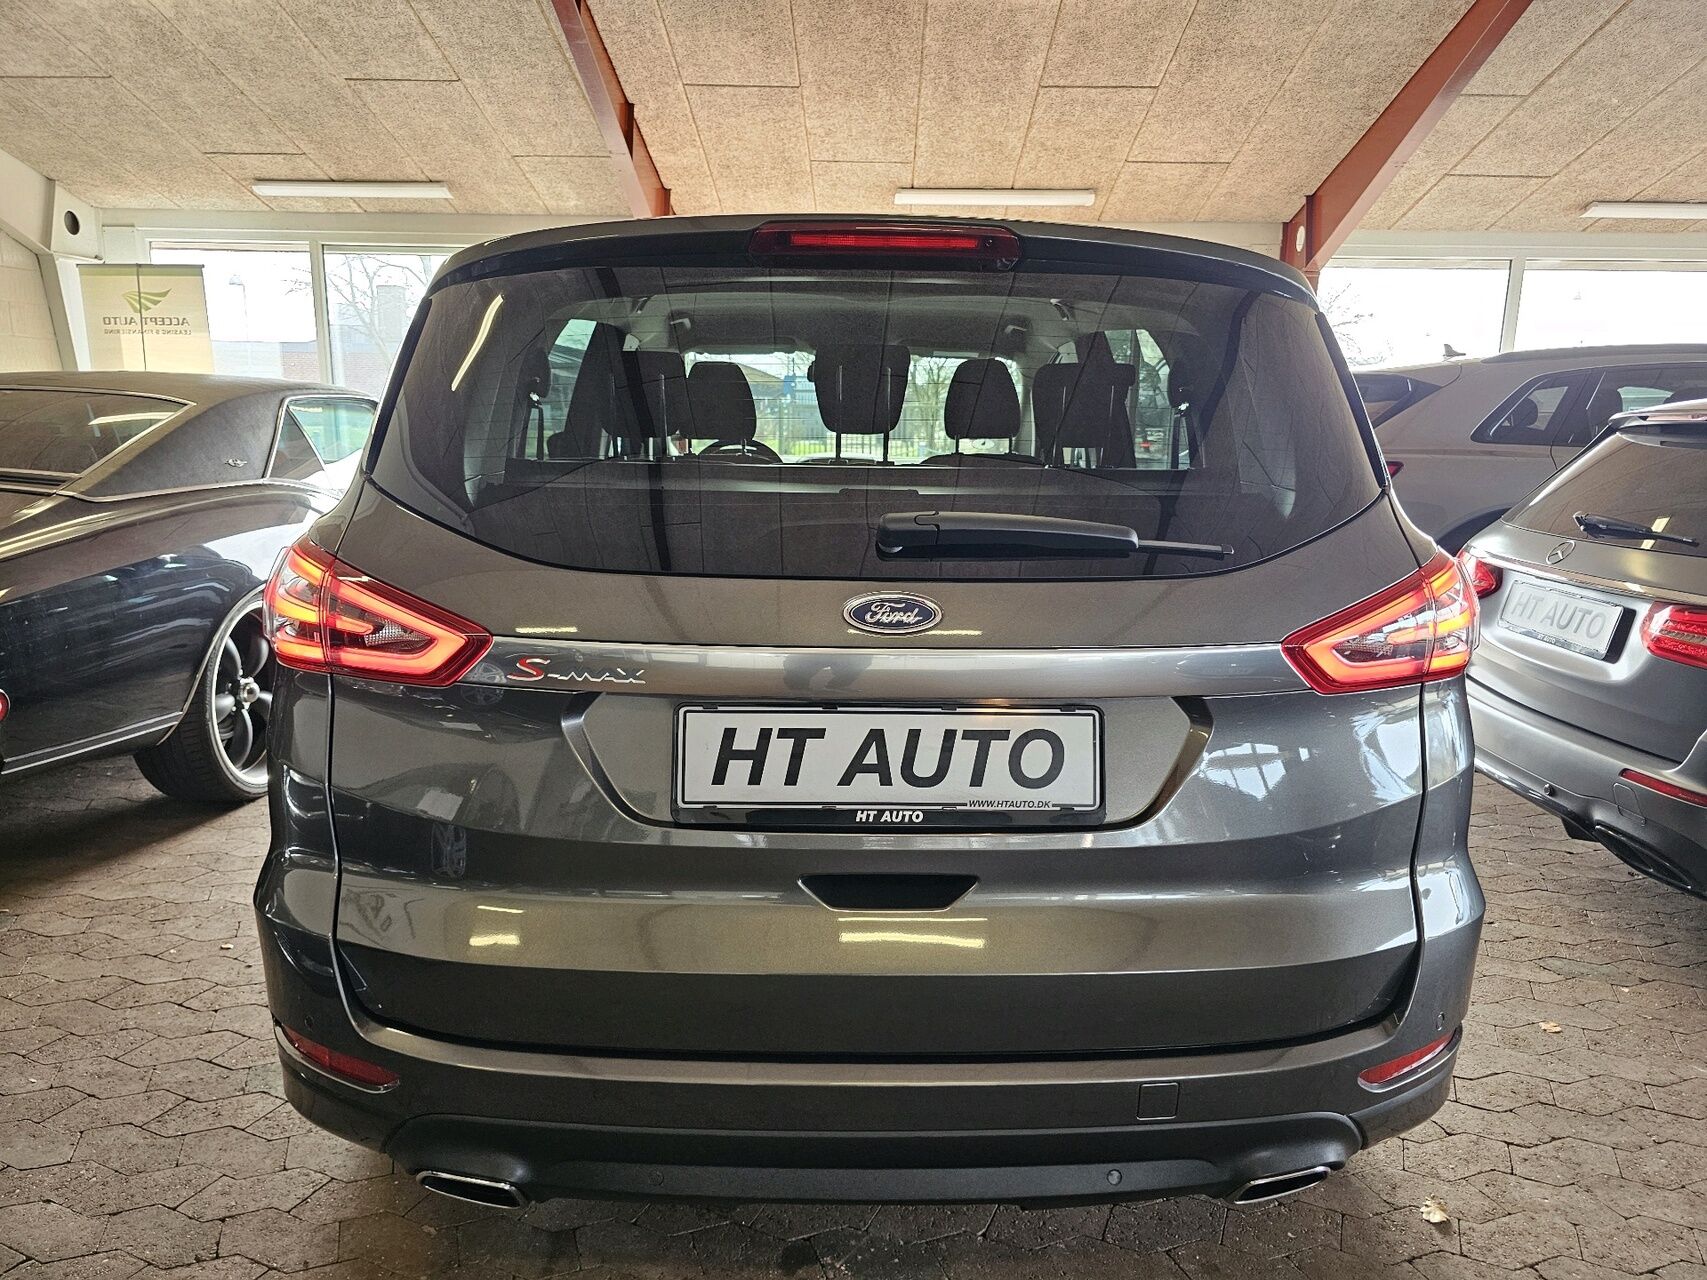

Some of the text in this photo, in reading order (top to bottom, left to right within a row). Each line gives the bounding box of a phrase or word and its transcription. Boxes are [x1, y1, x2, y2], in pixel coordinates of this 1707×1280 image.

[864, 602, 923, 624] Ford
[1511, 591, 1607, 639] HT AUTO
[711, 727, 1066, 789] HT AUTO
[968, 800, 1052, 809] WWW.HTAUTO.DK
[855, 810, 924, 823] HT AUTO
